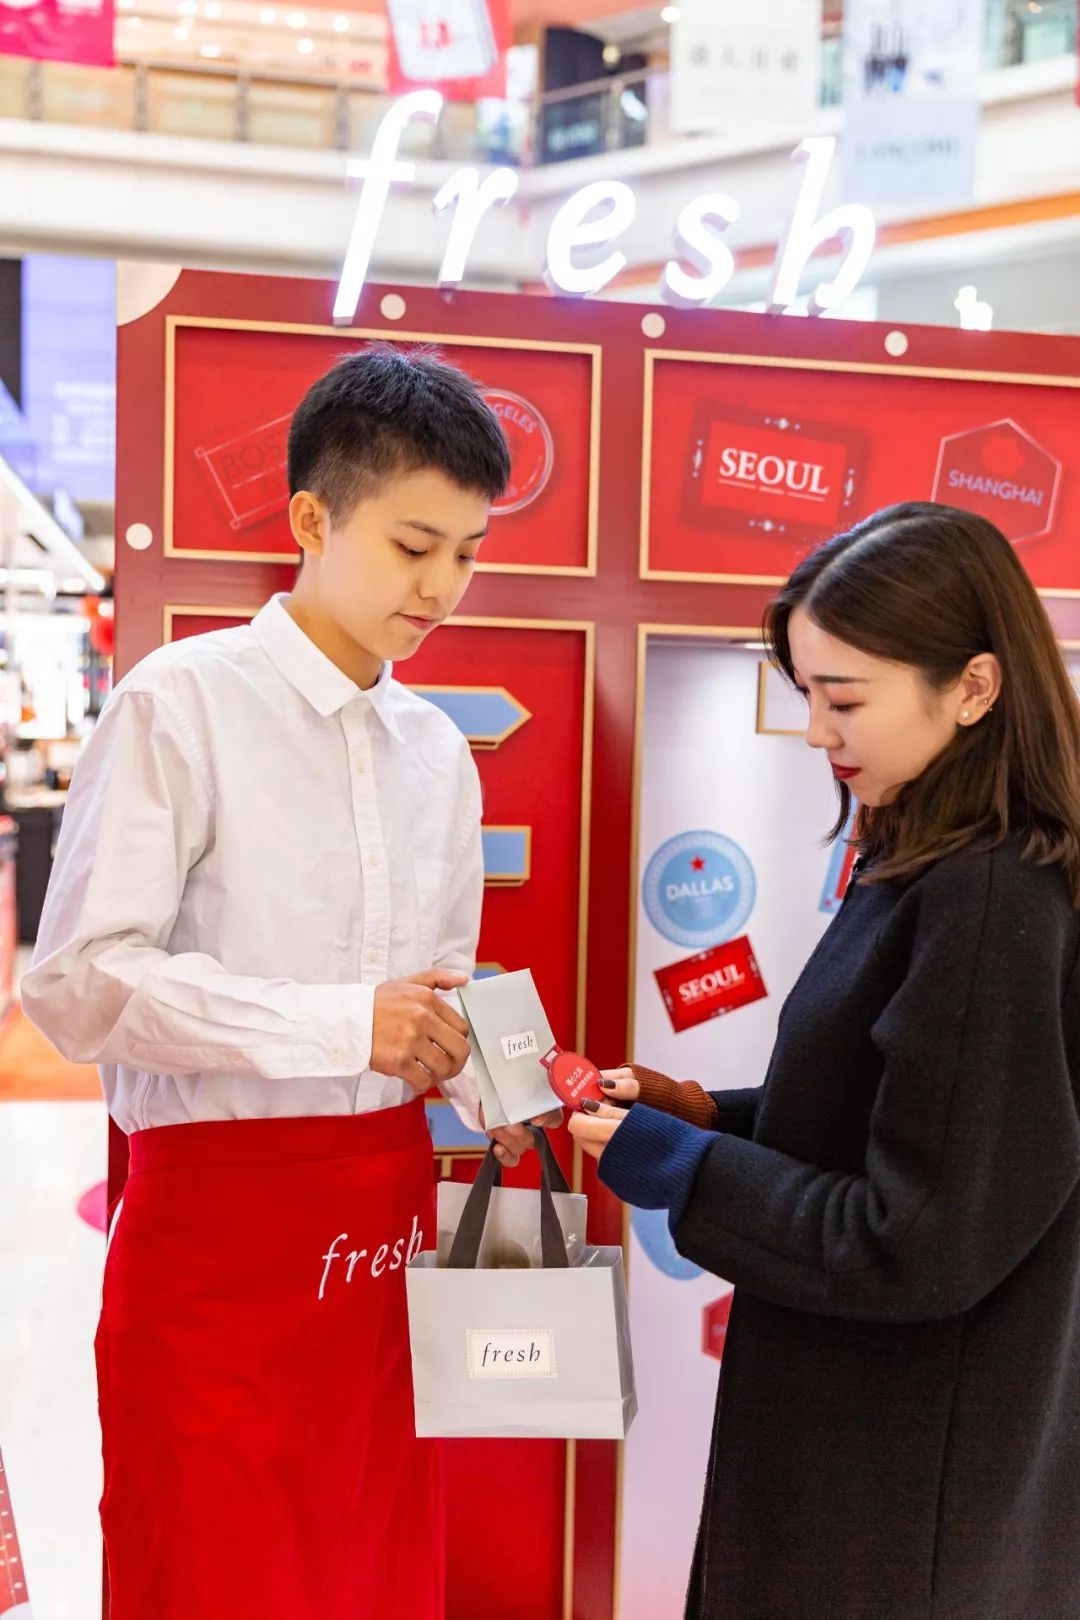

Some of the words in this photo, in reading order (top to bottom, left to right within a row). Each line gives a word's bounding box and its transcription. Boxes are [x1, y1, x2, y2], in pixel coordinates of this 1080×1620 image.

[331, 88, 878, 322] fresh
[492, 403, 537, 434] GELES
[220, 430, 289, 480] BOS
[718, 447, 830, 496] SEOUL
[947, 469, 1045, 507] SHANGHAI
[665, 874, 735, 901] DALLAS
[678, 962, 746, 1002] SEOUL
[506, 1033, 534, 1055] fresh
[317, 1215, 423, 1300] fresh
[481, 1342, 541, 1367] fresh
